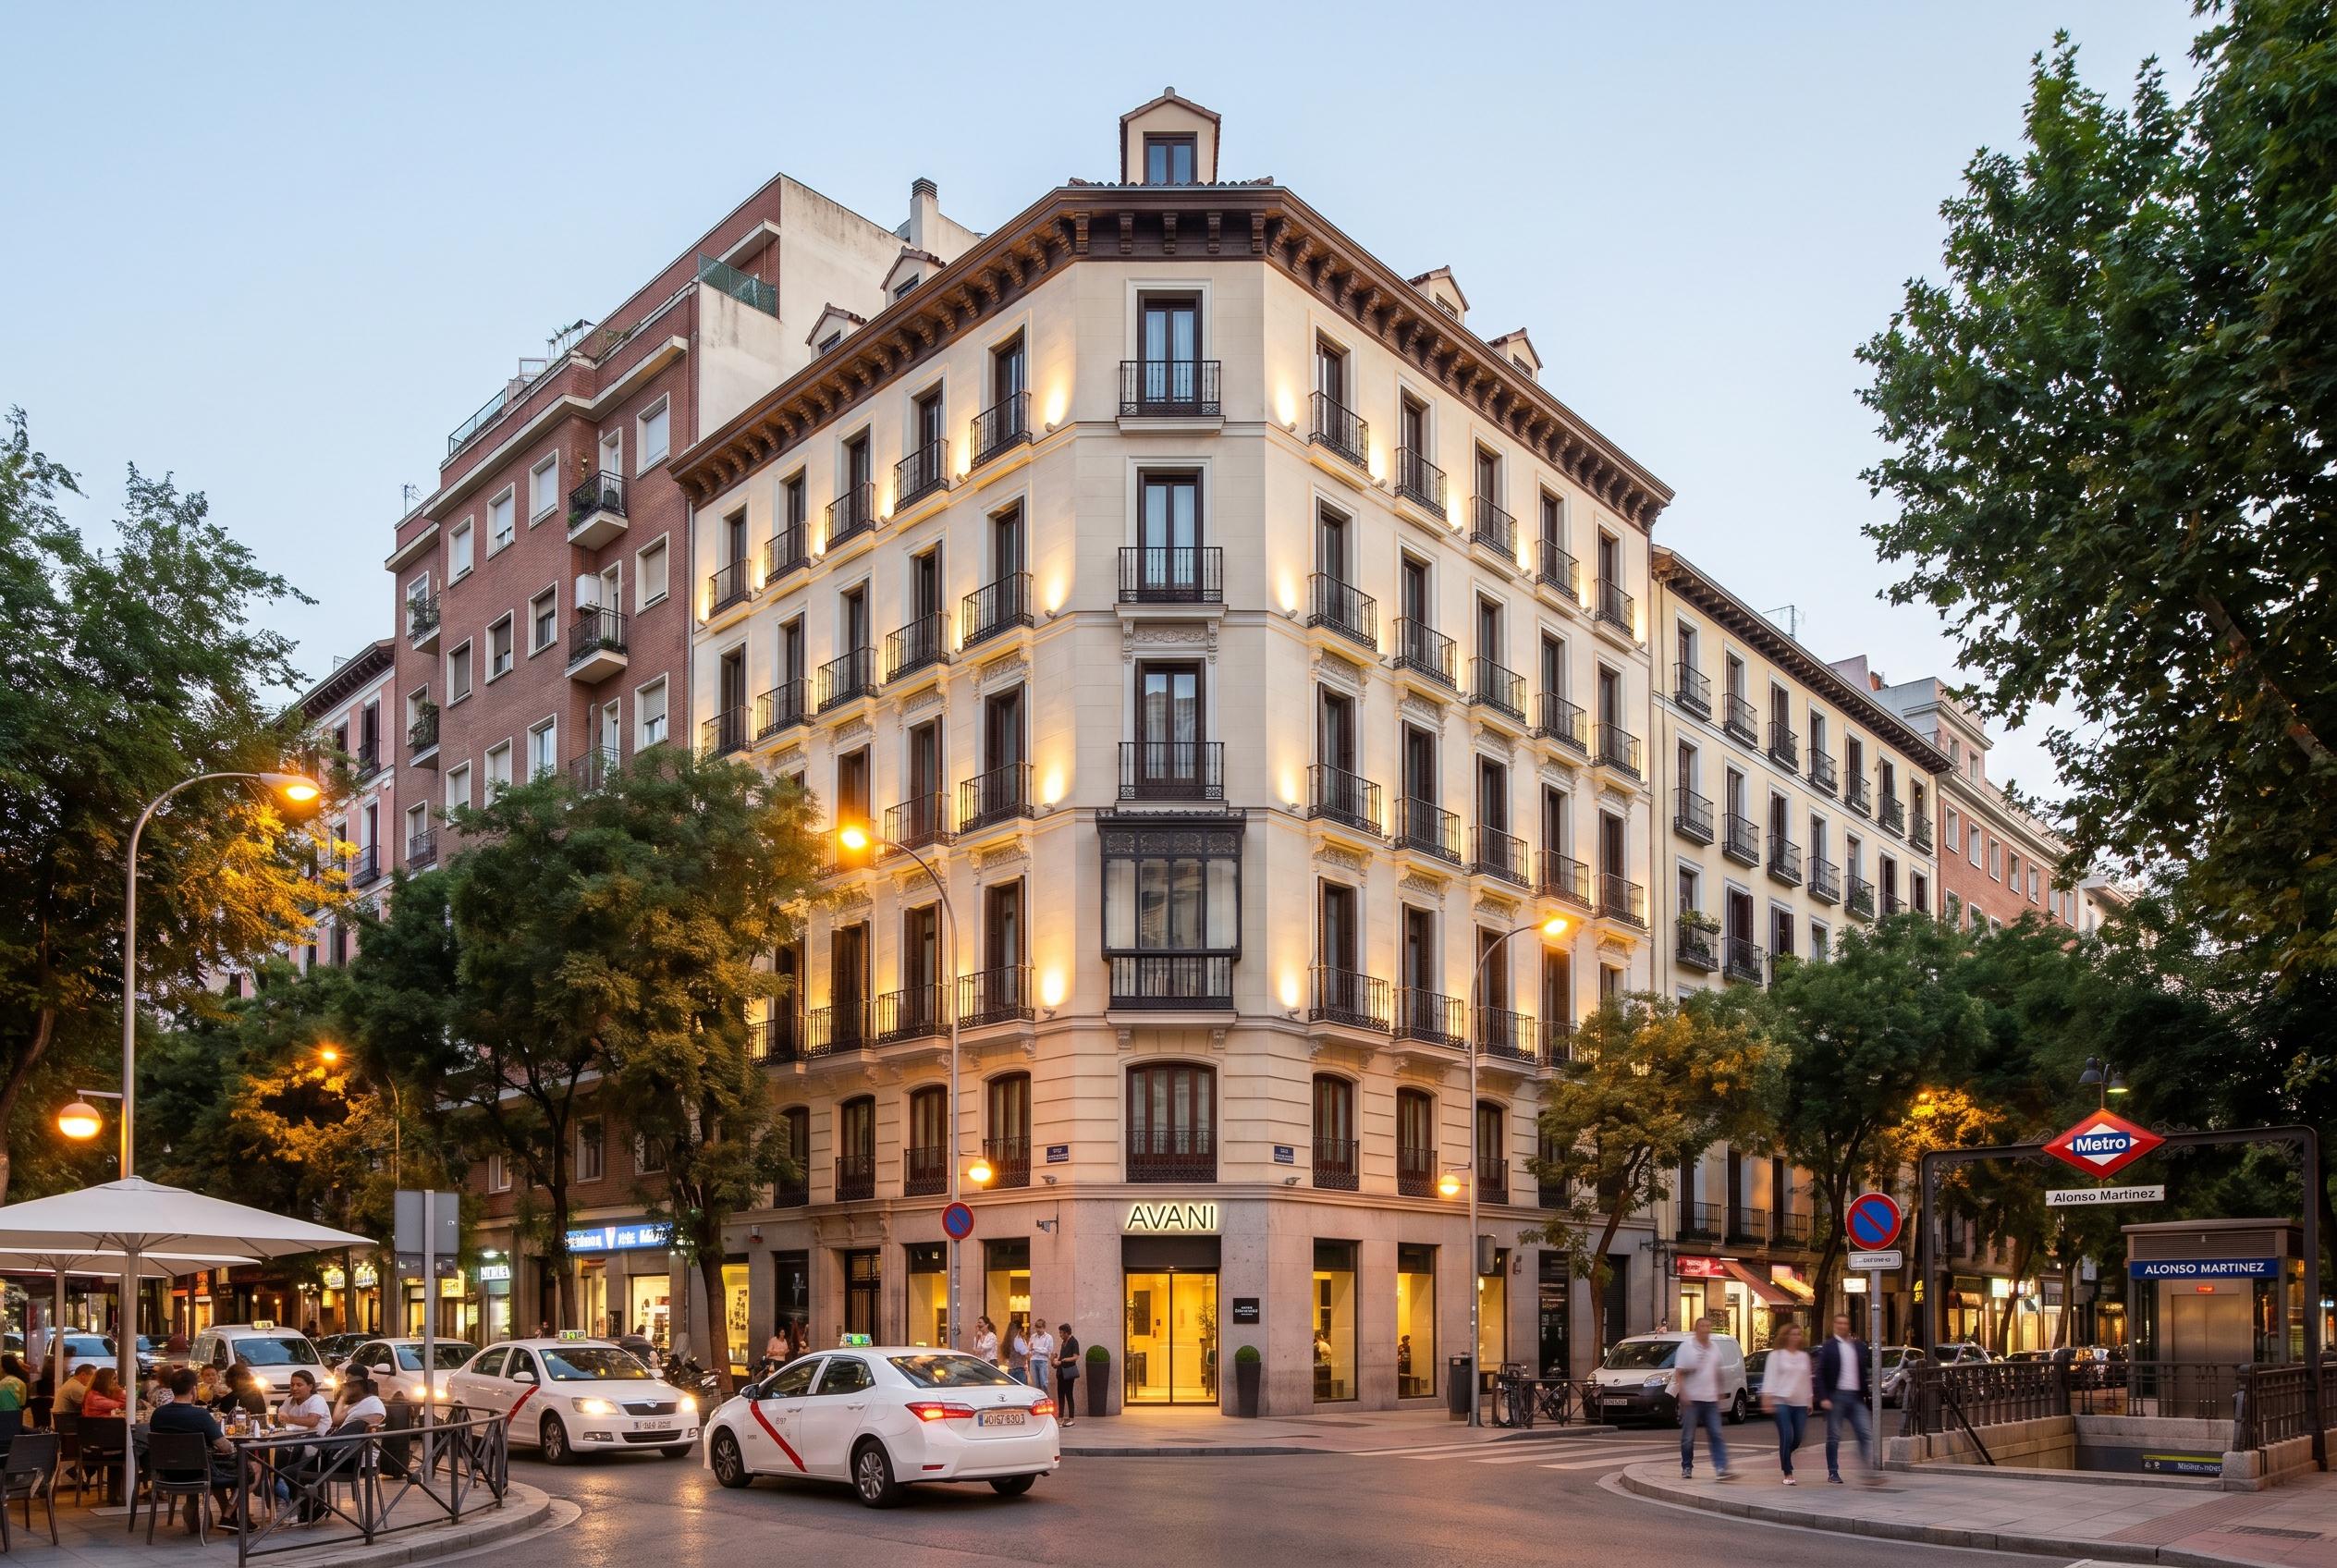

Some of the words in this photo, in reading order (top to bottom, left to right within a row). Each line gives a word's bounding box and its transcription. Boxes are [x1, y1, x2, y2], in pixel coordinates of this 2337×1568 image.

[2076, 1137, 2126, 1152] Metro
[2054, 1193, 2096, 1203] Alonso
[2100, 1190, 2156, 1200] Martinez
[1128, 1206, 1214, 1229] AVANI
[2145, 1264, 2196, 1275] ALONSO
[2200, 1262, 2265, 1273] MARTINEZ
